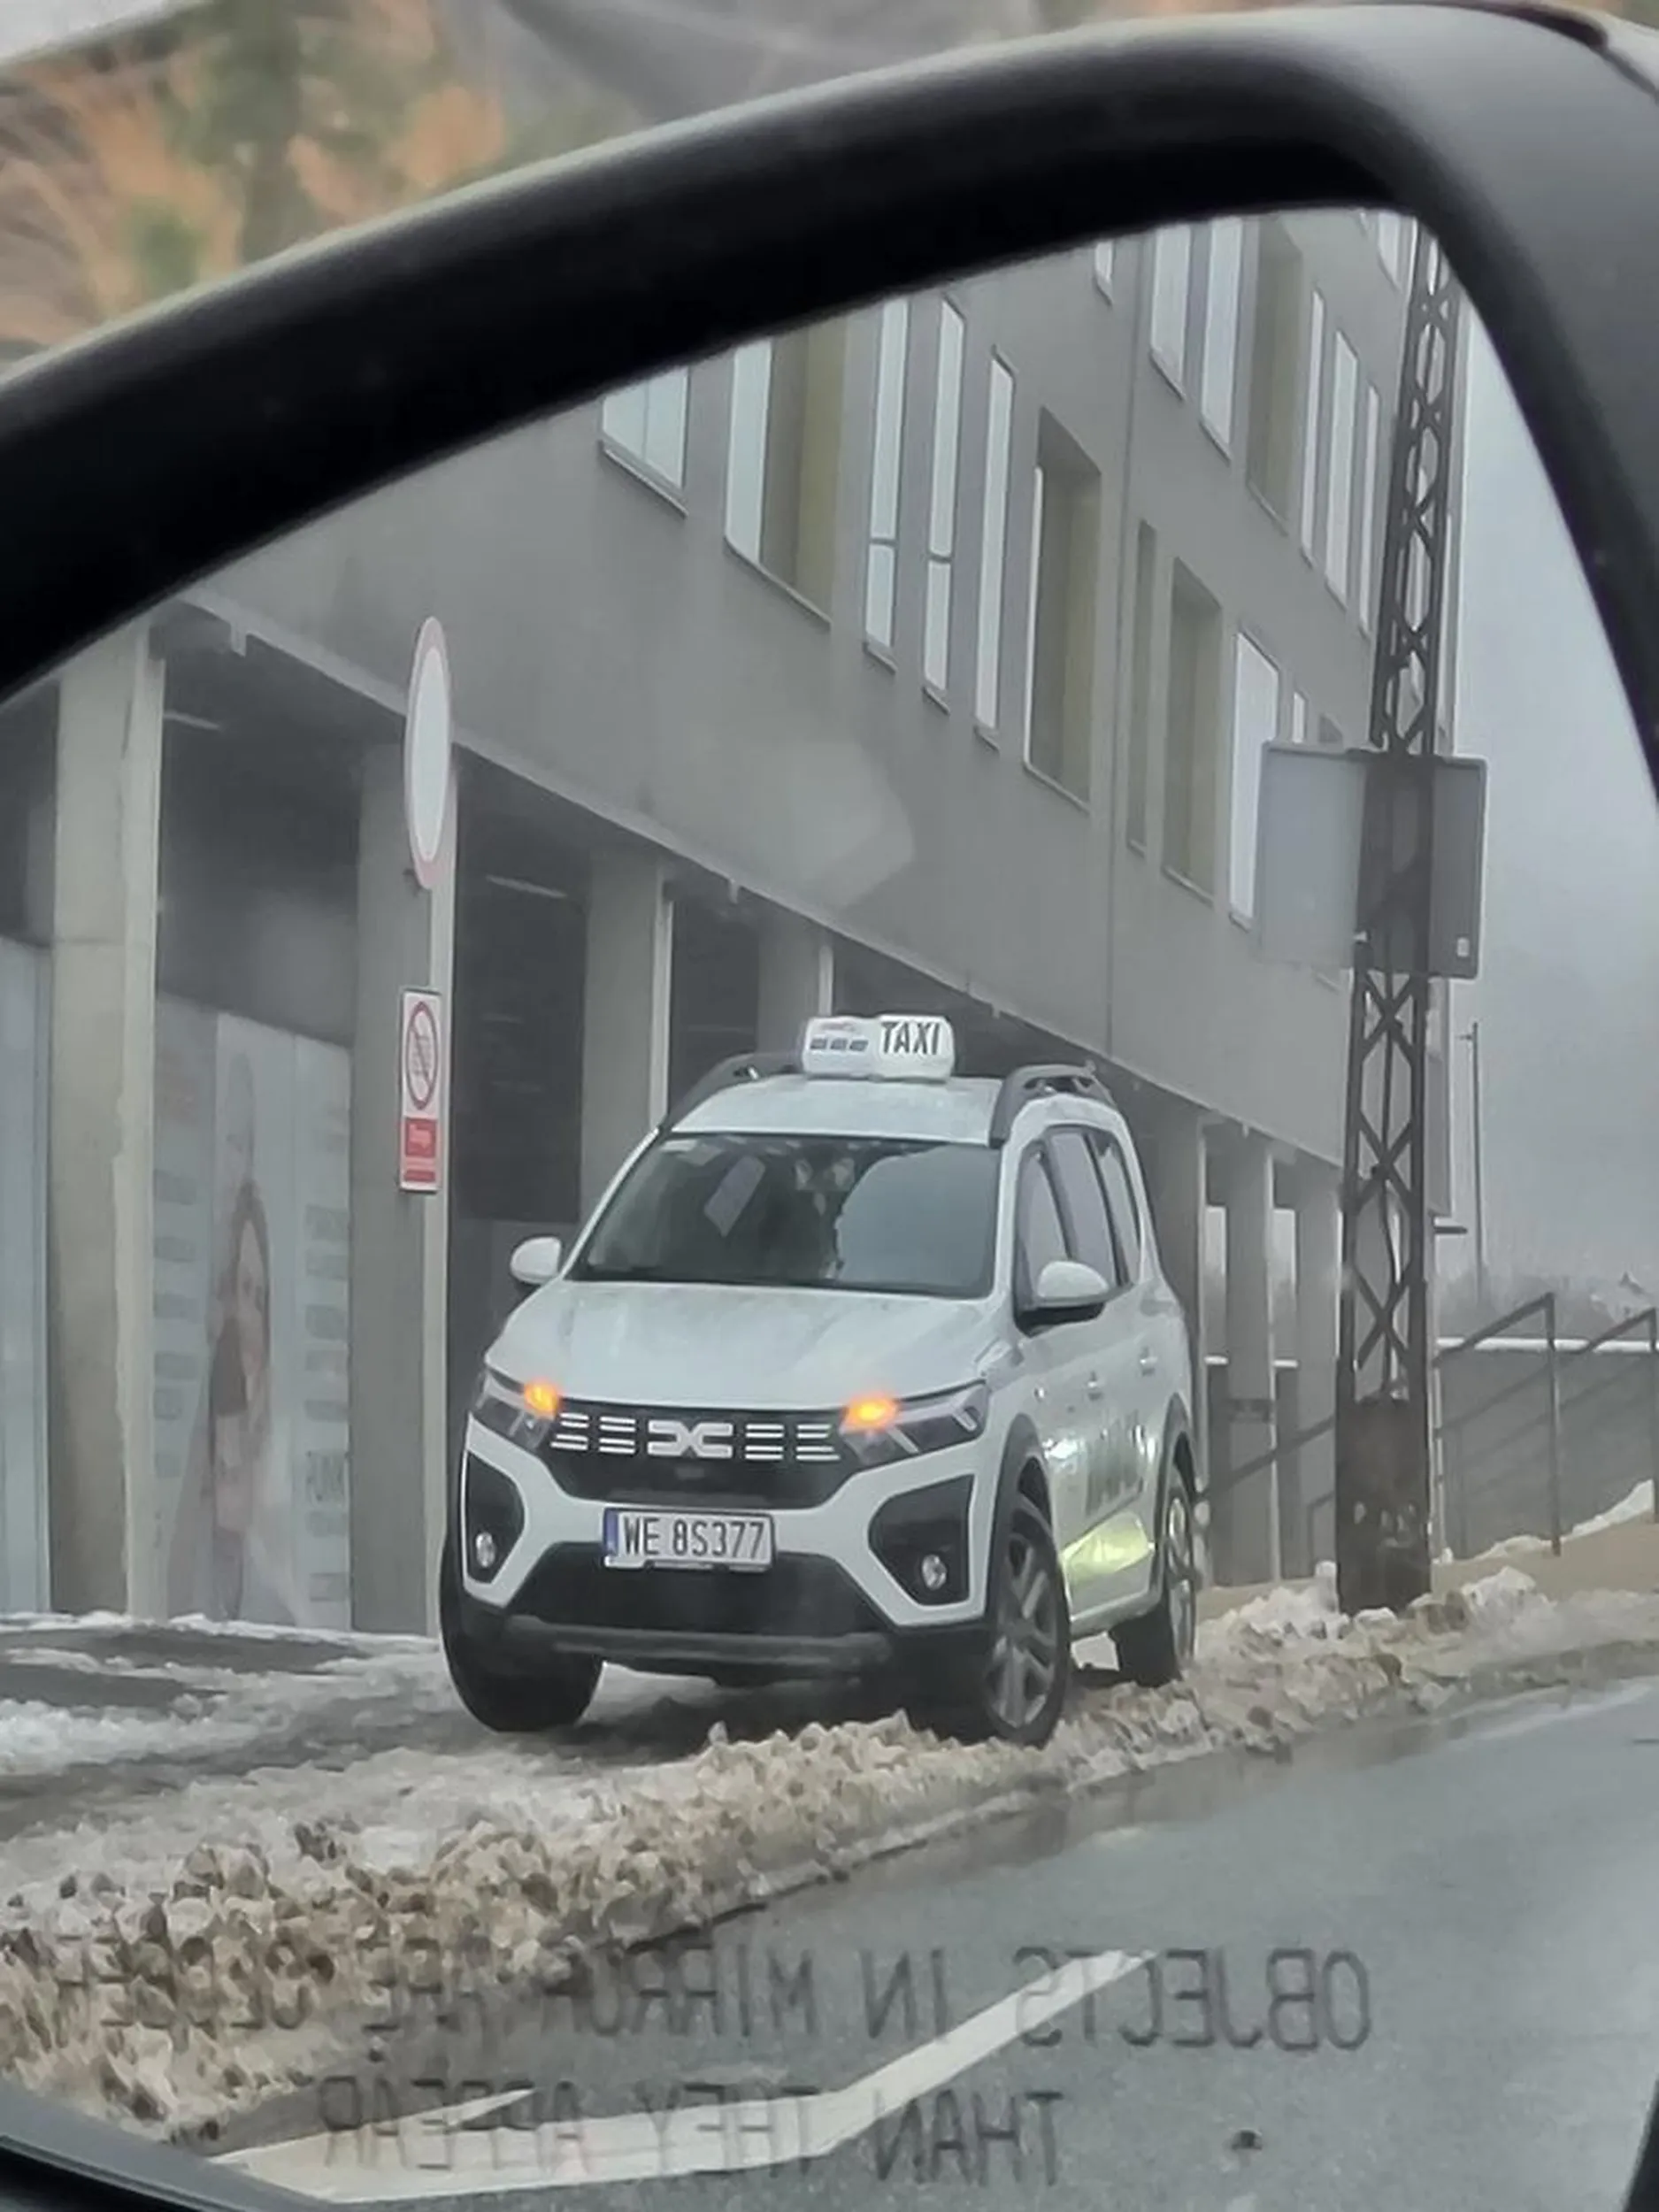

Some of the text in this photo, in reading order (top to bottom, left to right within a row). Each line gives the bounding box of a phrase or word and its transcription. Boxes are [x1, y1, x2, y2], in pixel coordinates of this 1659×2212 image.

[880, 1021, 940, 1056] TAXI
[623, 1517, 764, 1560] WE 8S377
